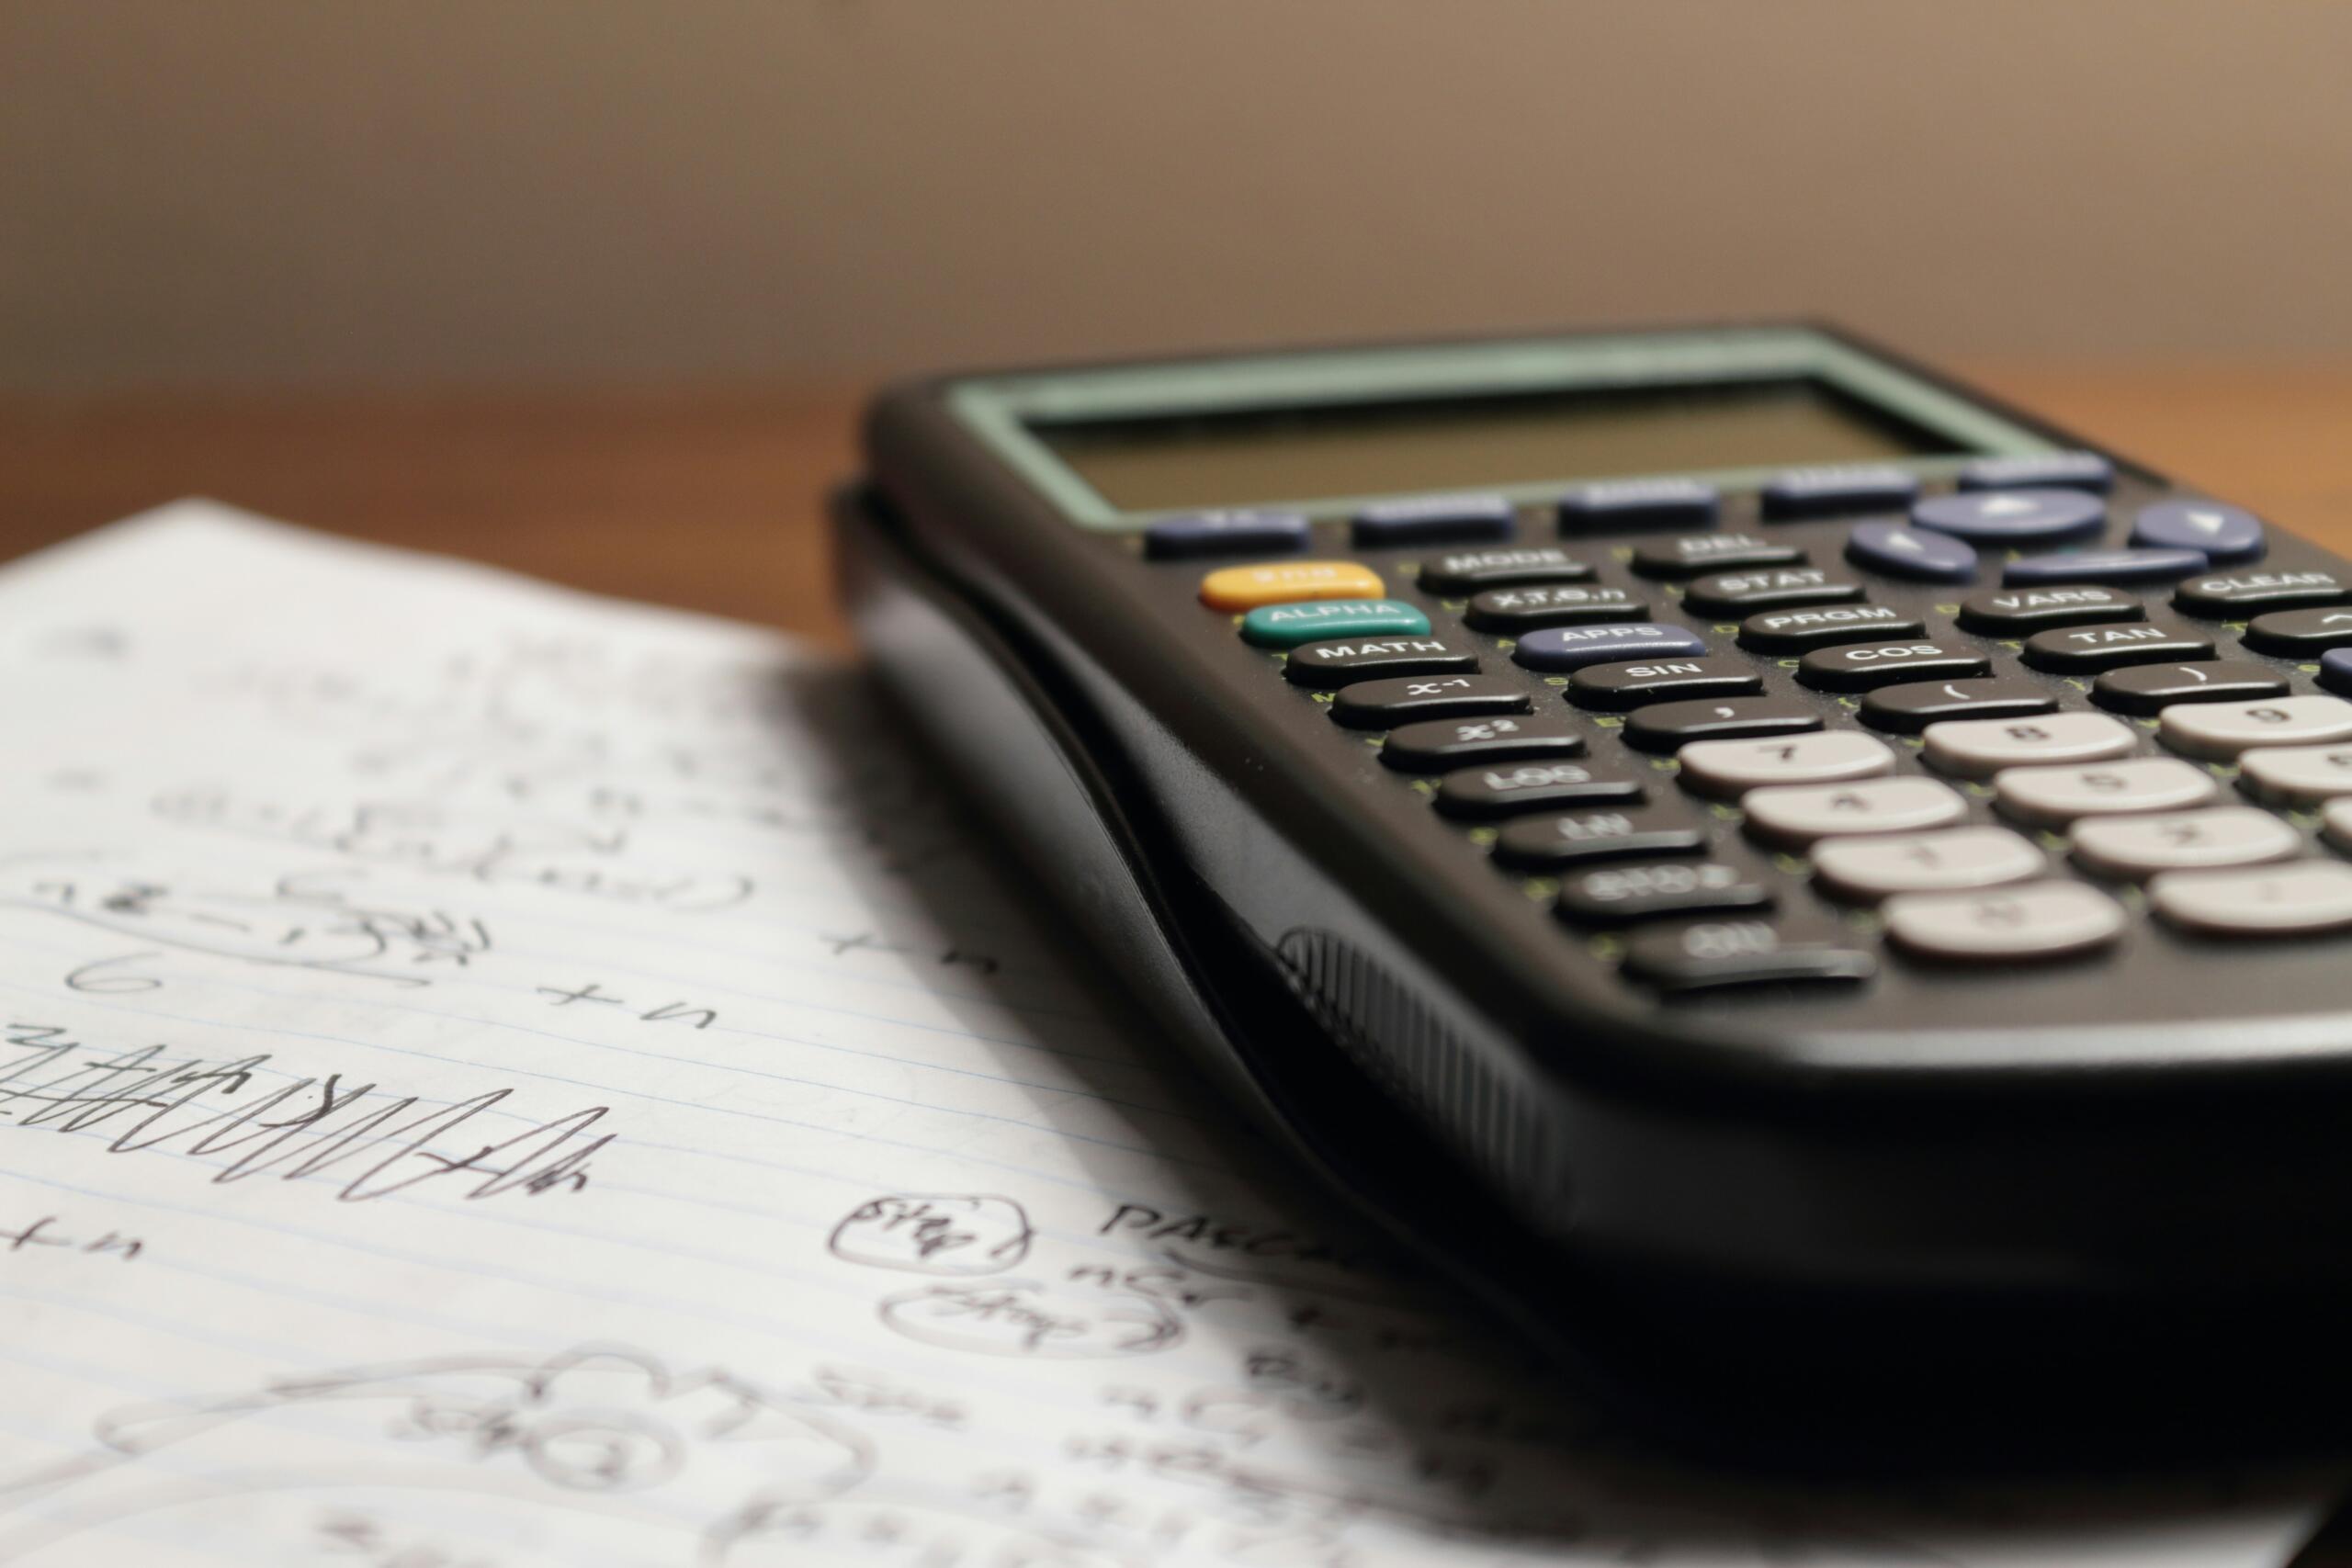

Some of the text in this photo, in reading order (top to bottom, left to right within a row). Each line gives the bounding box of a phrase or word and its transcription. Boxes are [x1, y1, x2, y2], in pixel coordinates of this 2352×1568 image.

[1445, 550, 1570, 572] MODE
[1717, 570, 1826, 592] STAT
[2202, 571, 2336, 592] CLEAR
[1992, 590, 2113, 610] VARS
[1268, 602, 1402, 624] ALPHA
[1764, 607, 1897, 629] PRGM
[1563, 626, 1665, 643] APPS
[2069, 628, 2168, 645] TAN
[1316, 640, 1449, 660] MATH
[1845, 645, 1944, 661] COS
[1625, 662, 1703, 678] SIN
[2178, 666, 2209, 682] )
[1943, 683, 1972, 701] (
[2245, 707, 2292, 724] 9
